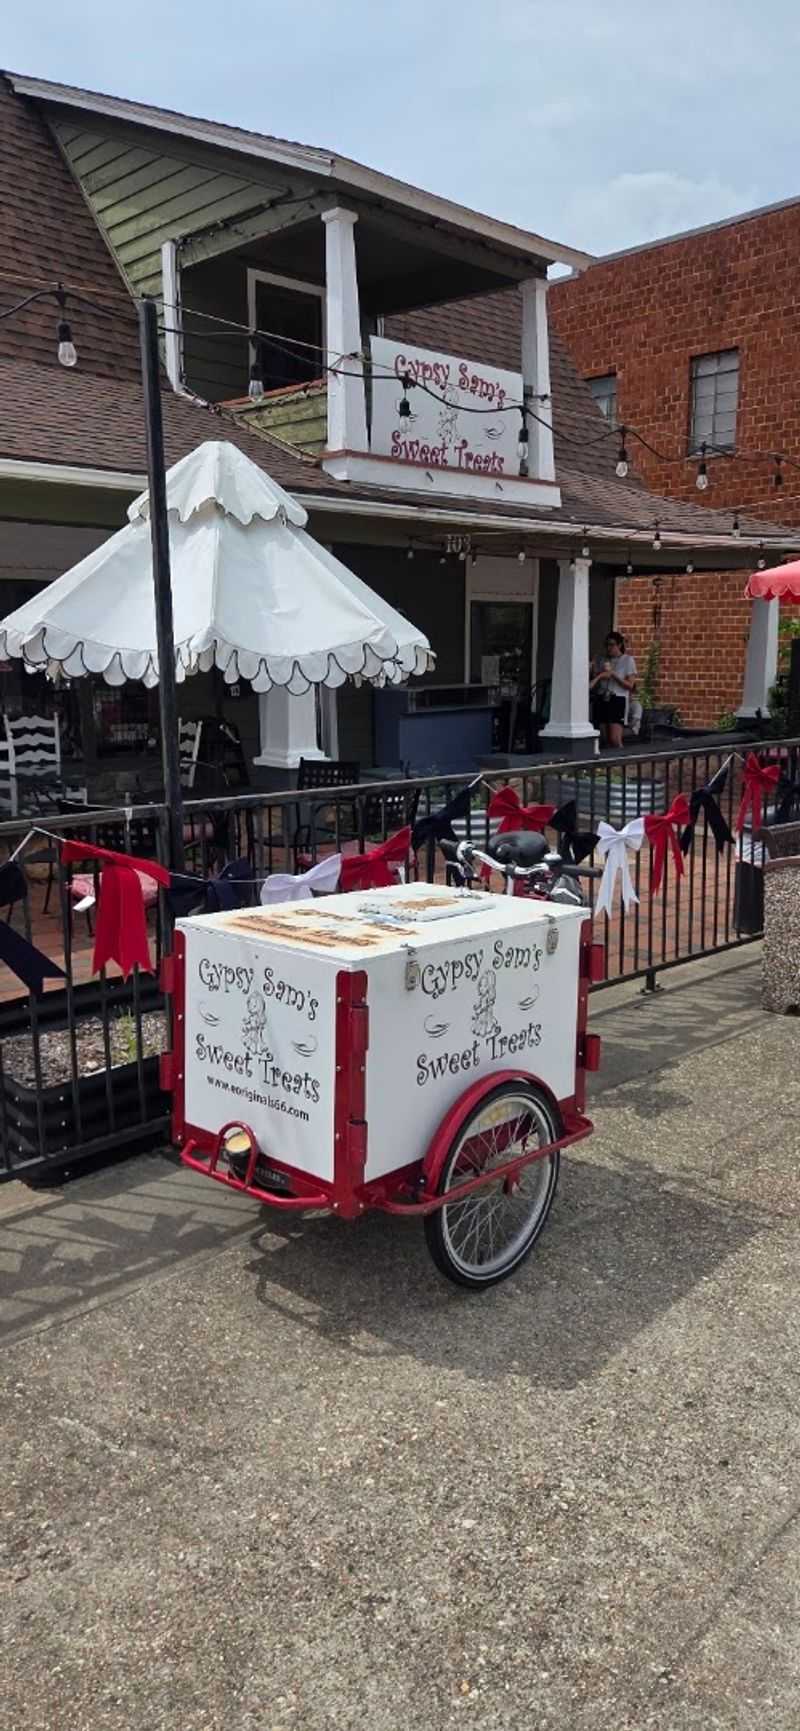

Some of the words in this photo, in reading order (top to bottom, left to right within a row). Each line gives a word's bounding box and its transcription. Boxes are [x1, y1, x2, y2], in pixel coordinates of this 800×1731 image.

[394, 354, 450, 390] Gypsy
[459, 363, 506, 409] Sam's
[391, 430, 448, 465] Sweet
[454, 439, 505, 473] Treats
[199, 958, 254, 994] Gypsy
[263, 968, 319, 1021] Sam's
[421, 949, 484, 999] Gypsy
[492, 940, 543, 971] Sam's
[196, 1033, 253, 1077] Sweet
[258, 1052, 320, 1103] Treats
[416, 1040, 480, 1086] Sweet
[486, 1022, 542, 1061] Treats
[206, 1075, 310, 1122] www.eoriginals66.com
